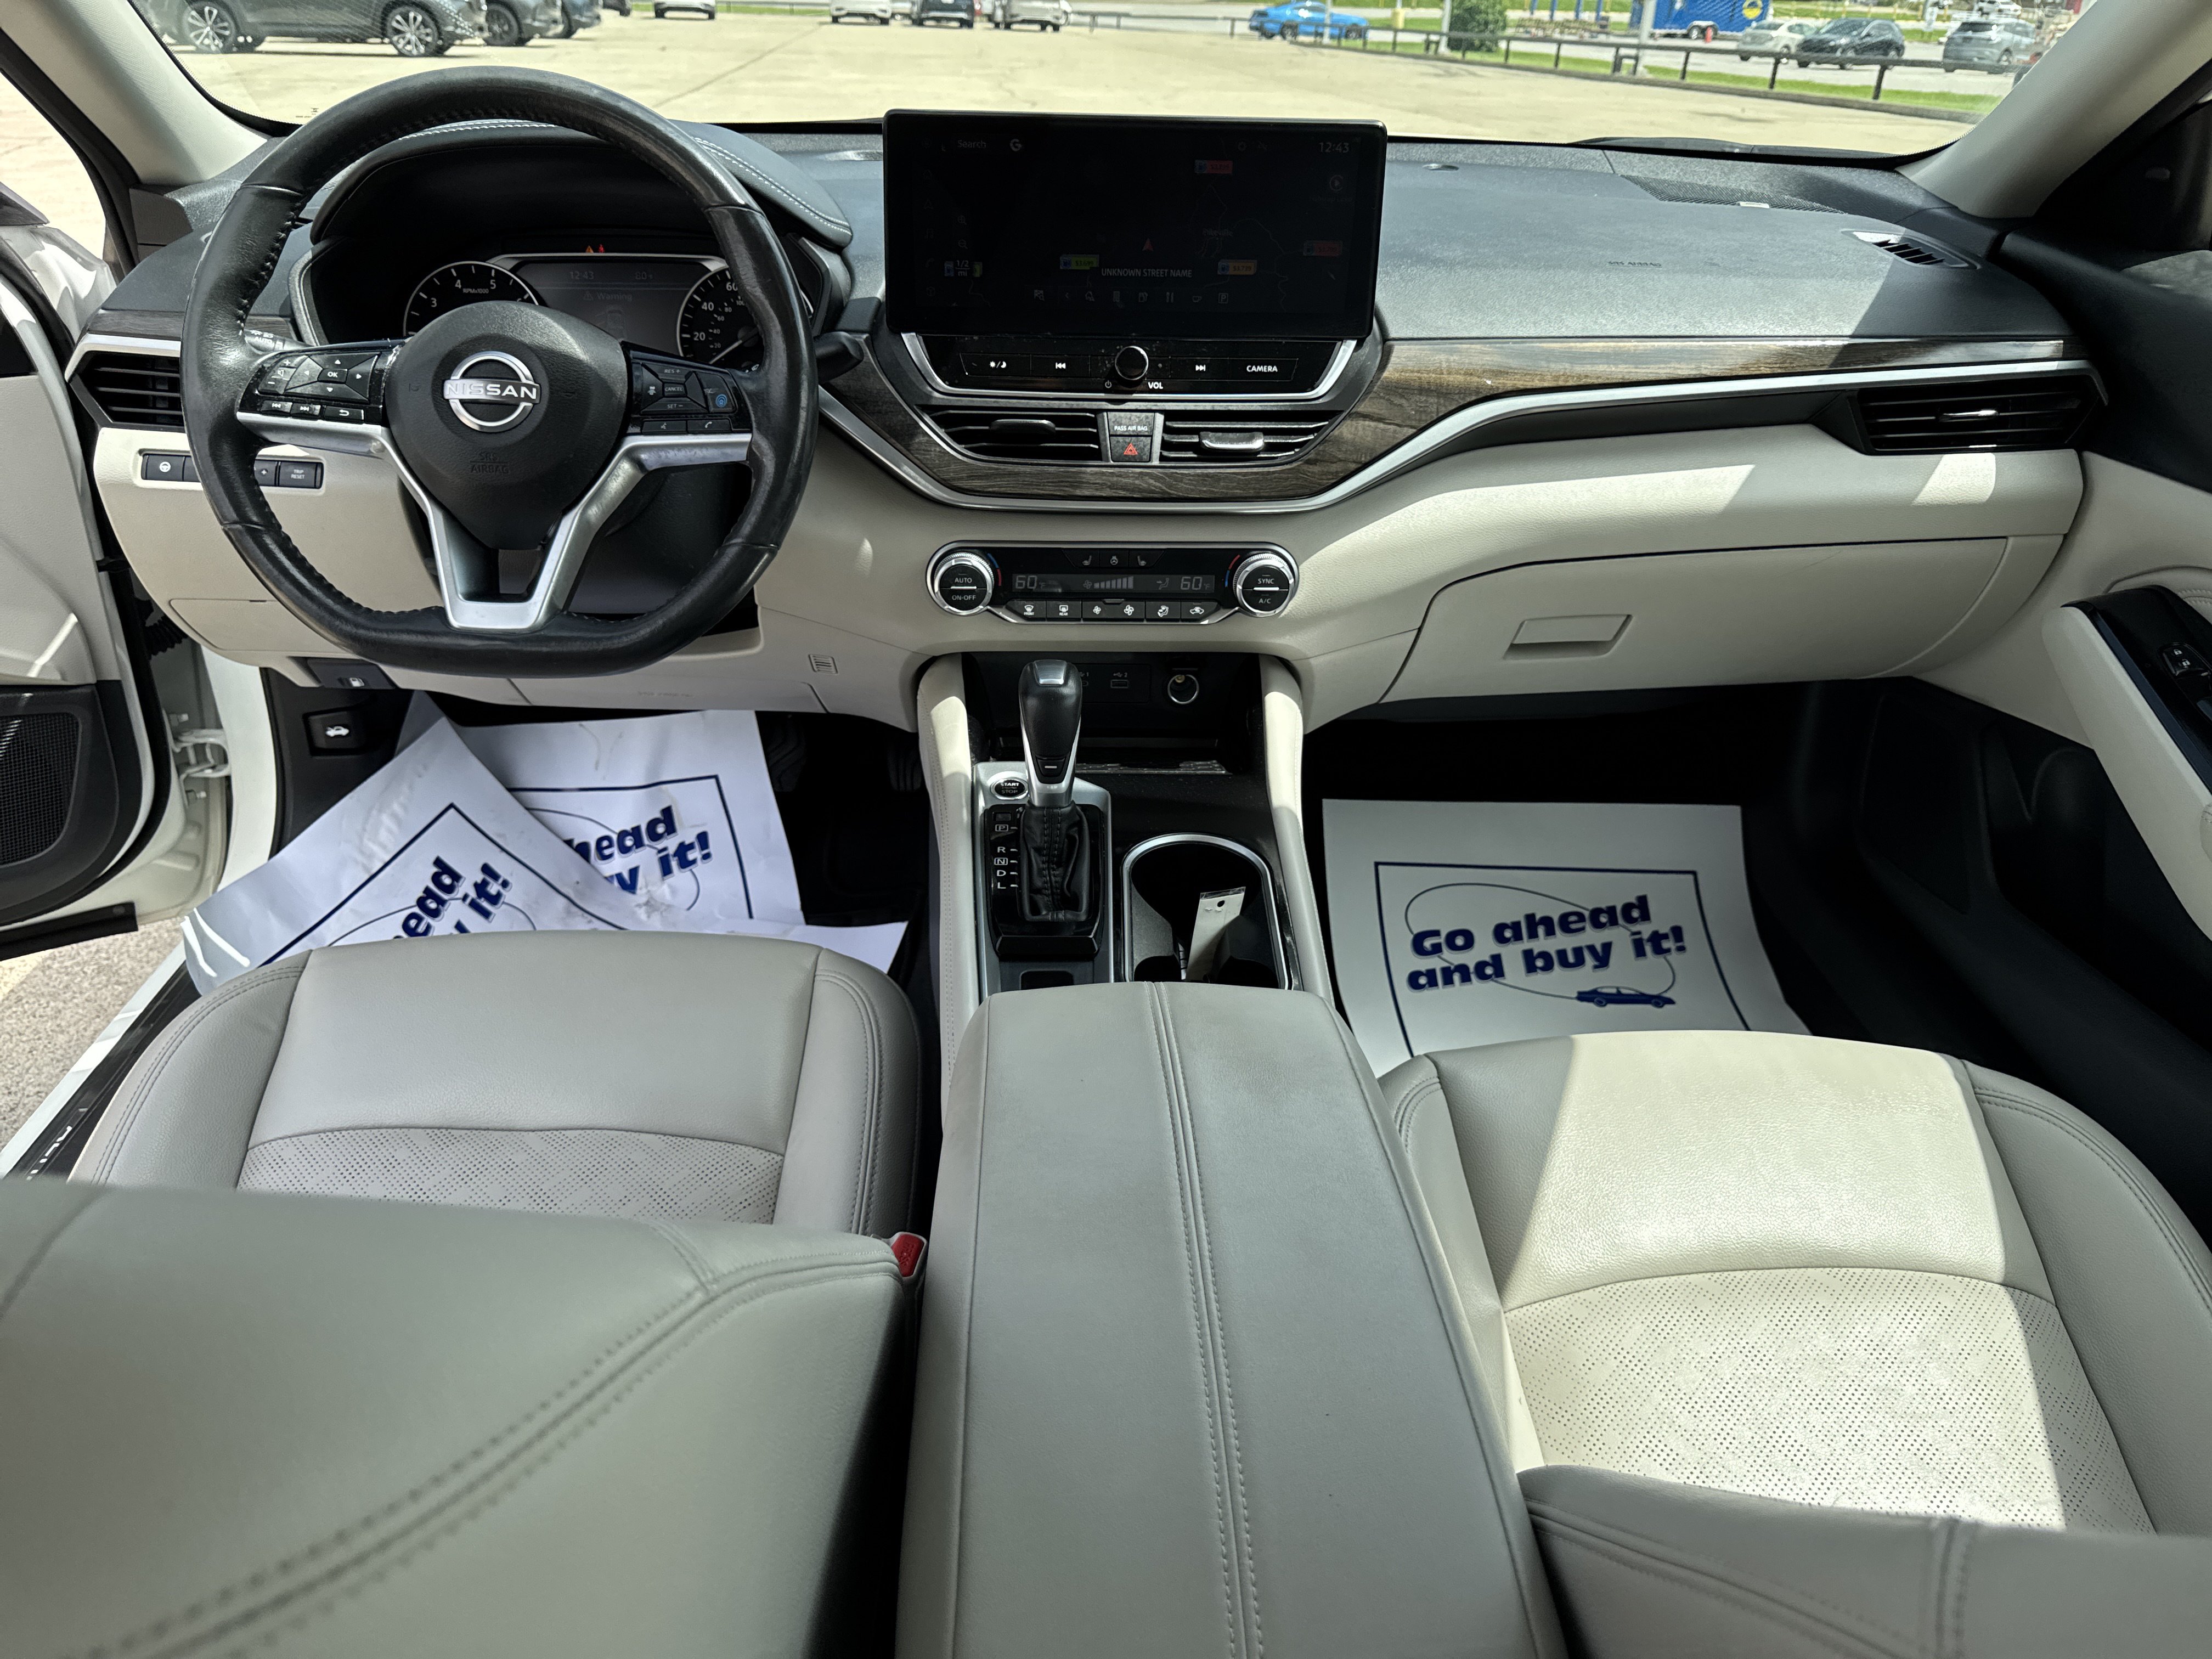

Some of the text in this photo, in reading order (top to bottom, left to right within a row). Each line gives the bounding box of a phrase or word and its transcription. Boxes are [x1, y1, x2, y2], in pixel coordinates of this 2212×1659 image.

[957, 139, 987, 150] Search
[1319, 142, 1350, 154] 12:43
[569, 271, 595, 280] 12:43
[1101, 268, 1193, 278] UNKNOWN STREET NAME
[455, 279, 462, 289] 4
[490, 279, 496, 290] 5
[726, 281, 738, 291] 60
[597, 291, 633, 302] Warning
[431, 297, 437, 308] 3
[701, 302, 714, 311] 40
[693, 331, 706, 341] 20
[1246, 365, 1278, 373] CAMERA
[446, 382, 537, 400] NISSAN
[1148, 381, 1164, 390] VOL
[657, 831, 713, 881] it!
[393, 855, 466, 940] ead
[461, 862, 513, 923] it!
[1410, 895, 1652, 958] Go ahead
[1406, 924, 1688, 991] and buy it!
